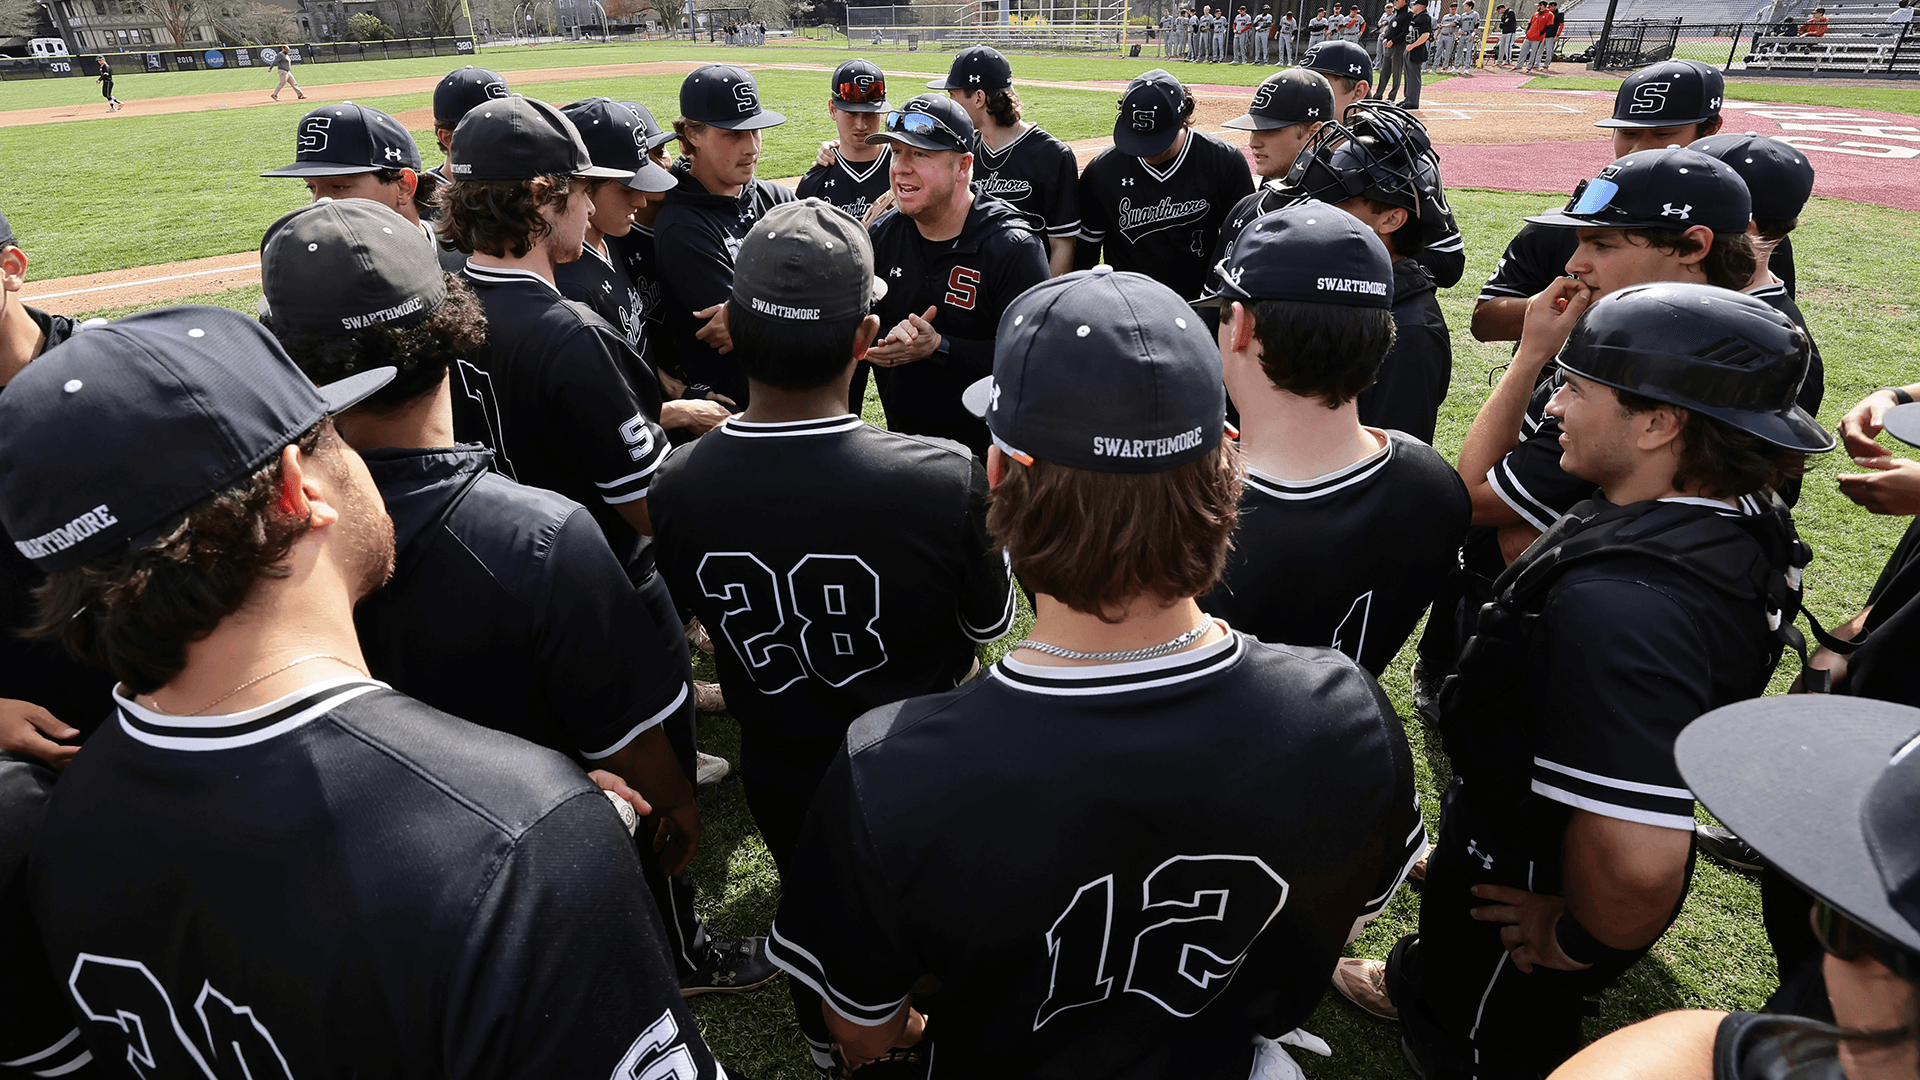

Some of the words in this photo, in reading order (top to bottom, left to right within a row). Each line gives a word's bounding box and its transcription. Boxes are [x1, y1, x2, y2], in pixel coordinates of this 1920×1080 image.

[456, 41, 473, 50] 320
[50, 62, 71, 73] 378
[732, 81, 759, 113] S
[1250, 83, 1279, 110] S
[1629, 82, 1671, 114] S
[298, 117, 332, 154] S
[1132, 110, 1155, 131] S
[976, 171, 1030, 193] rthmore
[1118, 196, 1209, 229] Swarthmore
[944, 265, 981, 310] S
[1316, 276, 1388, 296] SWARTHMORE
[340, 296, 423, 330] SWARTHMORE
[750, 297, 821, 322] SWARTHMORE
[1093, 426, 1204, 460] SWARTHMORE
[14, 503, 119, 560] ARTHMORE
[696, 551, 889, 695] 28
[1033, 854, 1290, 1032] 12
